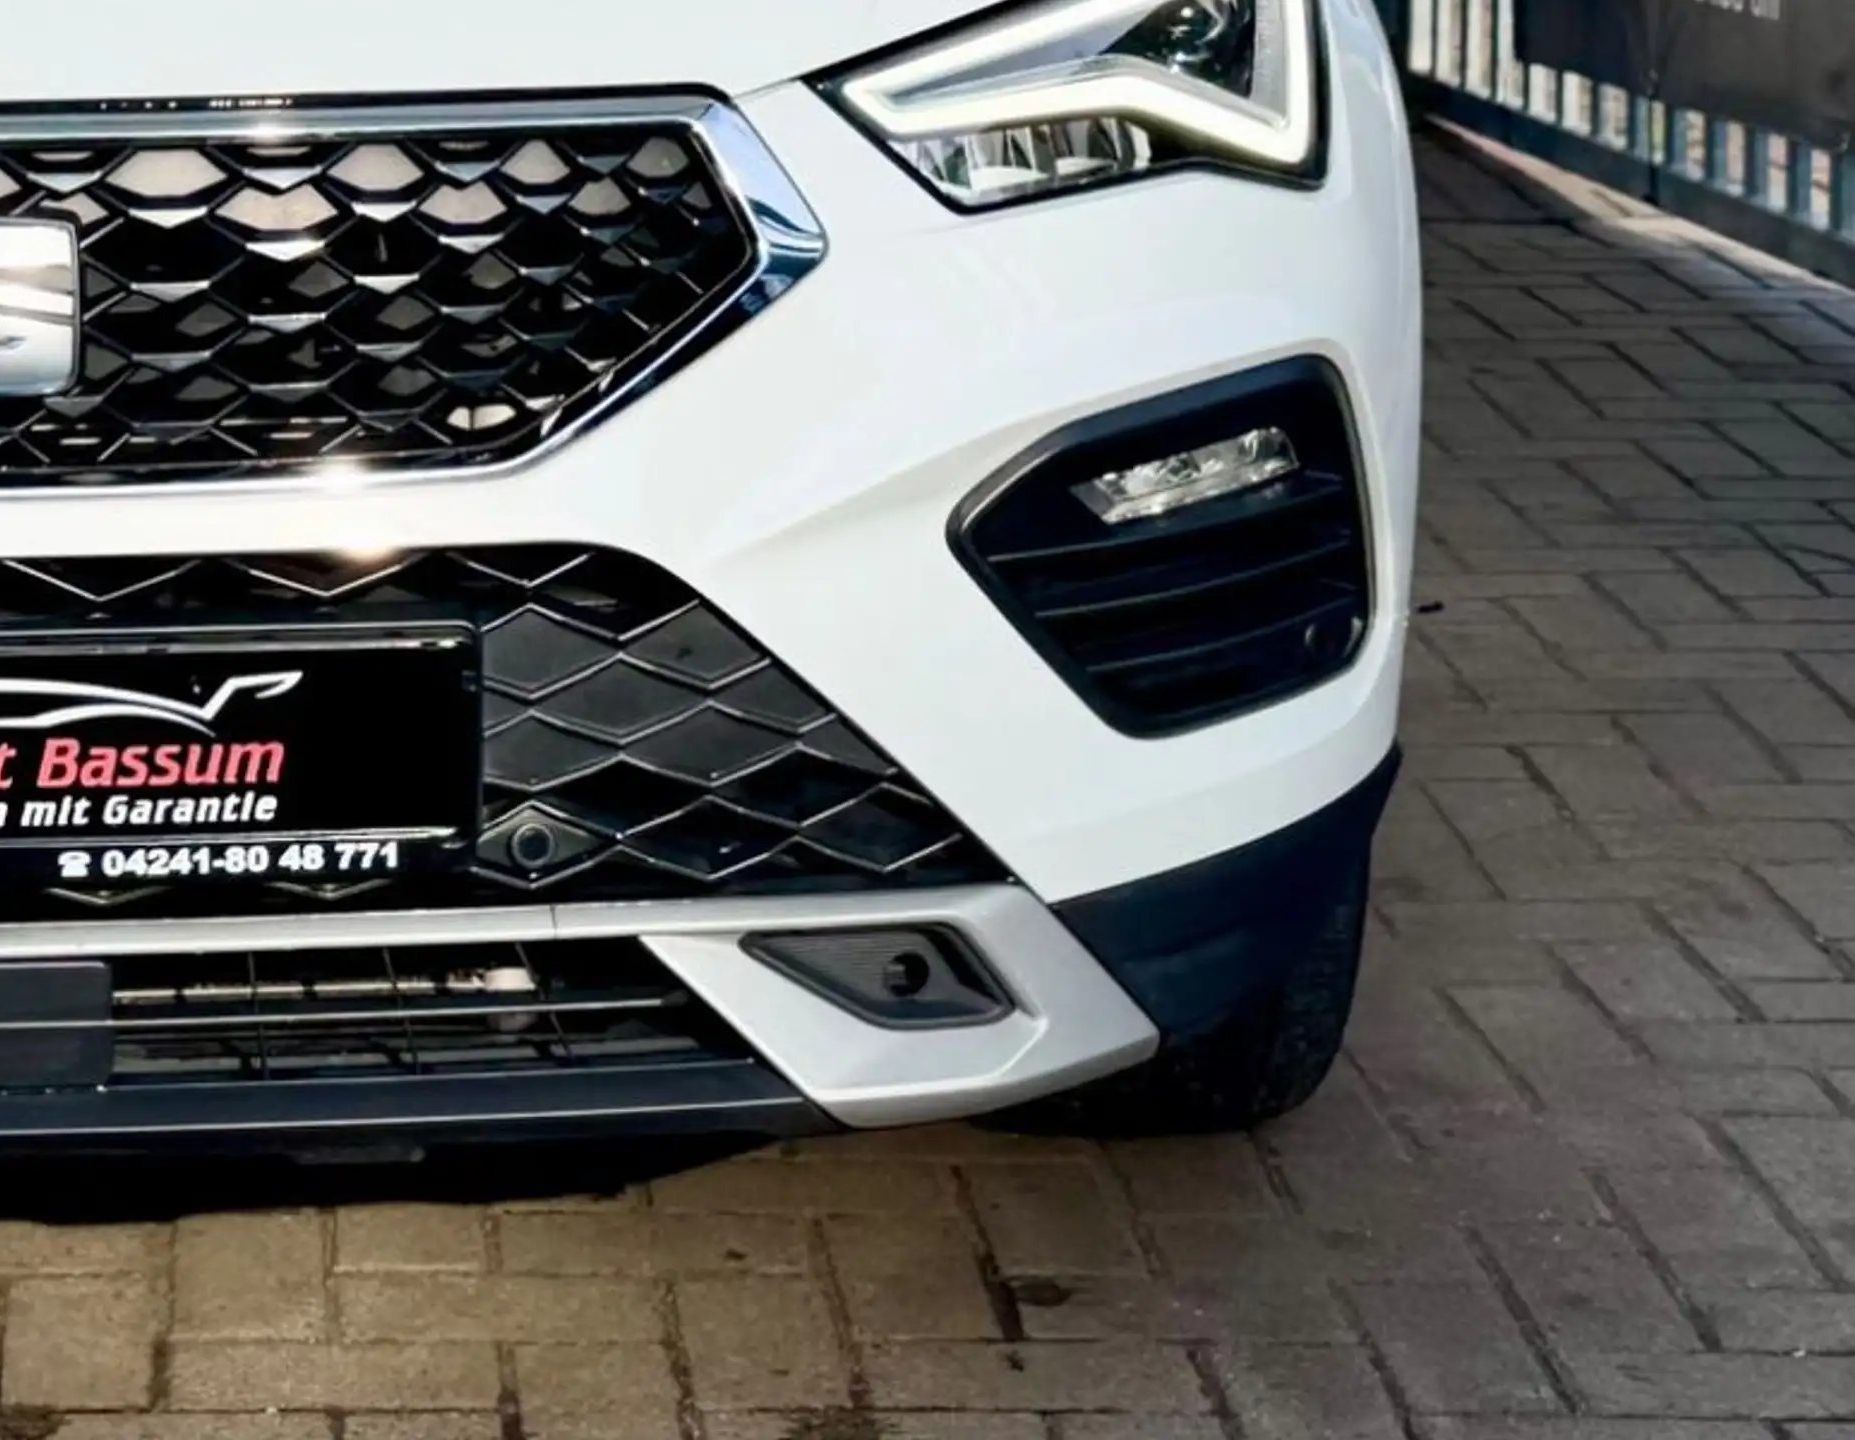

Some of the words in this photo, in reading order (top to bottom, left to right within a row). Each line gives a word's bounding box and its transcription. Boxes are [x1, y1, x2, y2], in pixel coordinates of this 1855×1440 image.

[36, 737, 285, 789] Bassum
[20, 795, 91, 828] mit
[102, 791, 278, 826] Garantie
[102, 845, 270, 877] 04241-80
[278, 843, 325, 871] 48
[334, 841, 399, 870] 771
